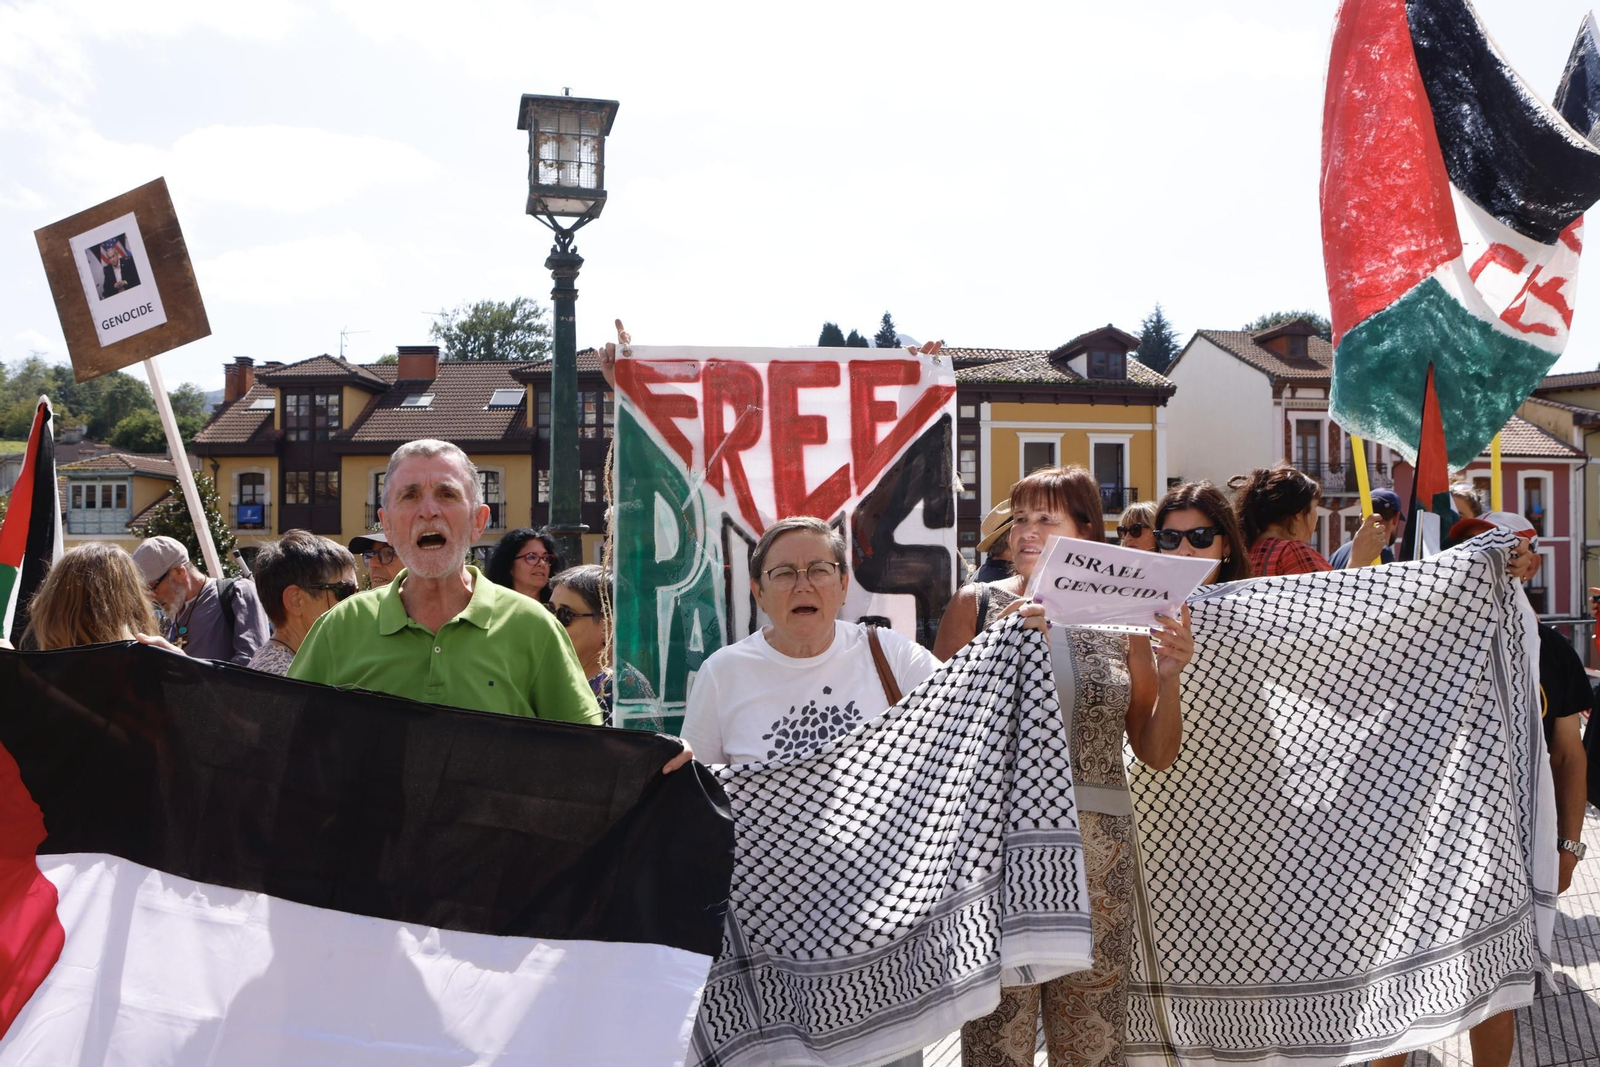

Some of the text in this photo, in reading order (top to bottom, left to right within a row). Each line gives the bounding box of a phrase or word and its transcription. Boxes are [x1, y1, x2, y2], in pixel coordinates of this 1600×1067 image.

[101, 302, 154, 330] GENOCIDE
[614, 359, 956, 537] FREE
[1064, 552, 1146, 580] ISRAEL
[1054, 577, 1169, 600] GENOCIDA
